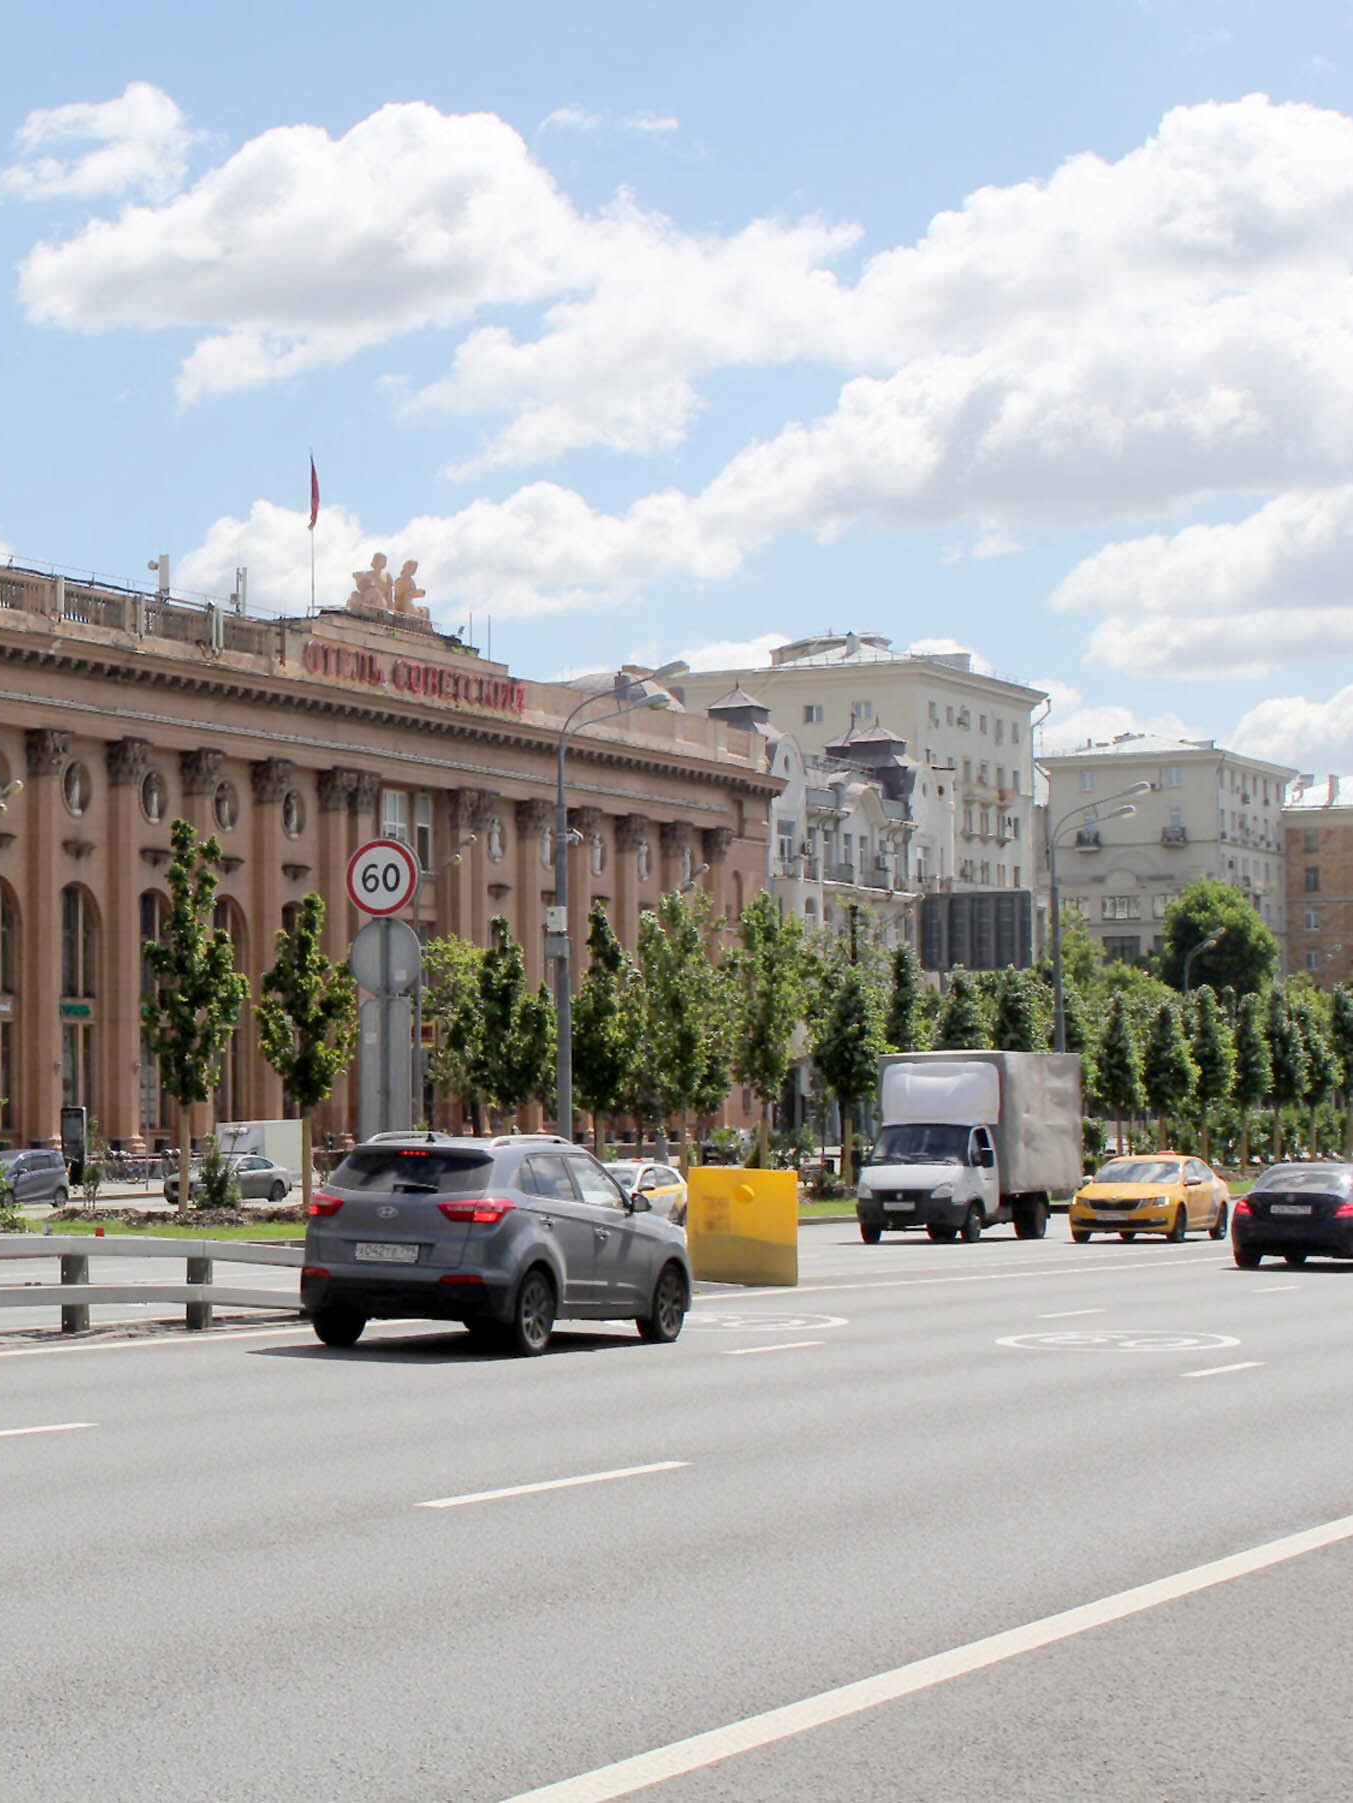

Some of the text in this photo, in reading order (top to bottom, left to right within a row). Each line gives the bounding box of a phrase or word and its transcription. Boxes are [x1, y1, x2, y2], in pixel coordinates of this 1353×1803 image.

[303, 639, 525, 713] ОТЕЛЬ СОВЕТСКИЙ
[361, 862, 401, 893] 60
